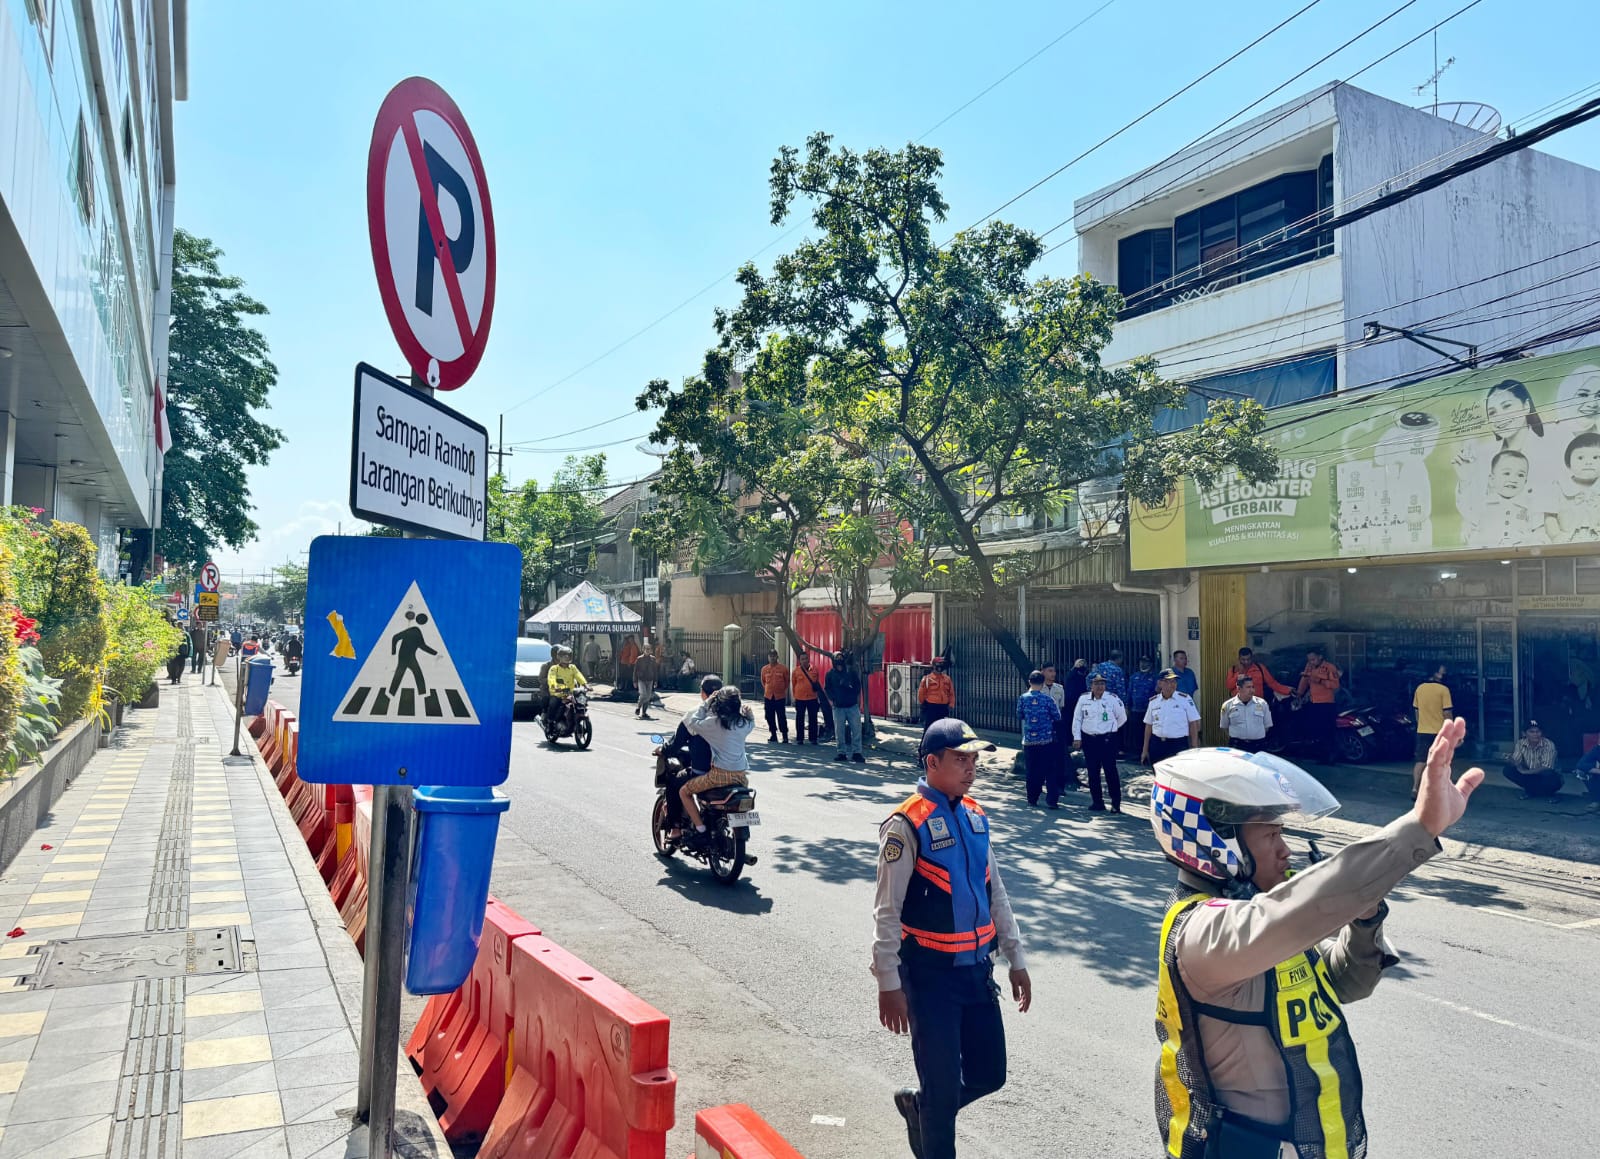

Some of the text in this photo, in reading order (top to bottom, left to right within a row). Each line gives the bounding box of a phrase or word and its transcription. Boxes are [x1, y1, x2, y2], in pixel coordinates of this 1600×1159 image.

[415, 139, 475, 318] P
[376, 405, 431, 458] Sampai
[361, 451, 482, 527] Larangan Berikutnya
[1228, 479, 1312, 502] BOOSTER
[1222, 500, 1282, 518] TERBAIK
[1224, 521, 1281, 534] MENINGKATKAN
[1208, 533, 1242, 547] KUALITAS
[1240, 532, 1247, 540] &
[1247, 530, 1285, 540] KUANTITAS
[206, 569, 216, 585] P
[558, 623, 640, 632] PEMERINTAH KOTA SURABAYA
[1288, 965, 1309, 985] FIYAN
